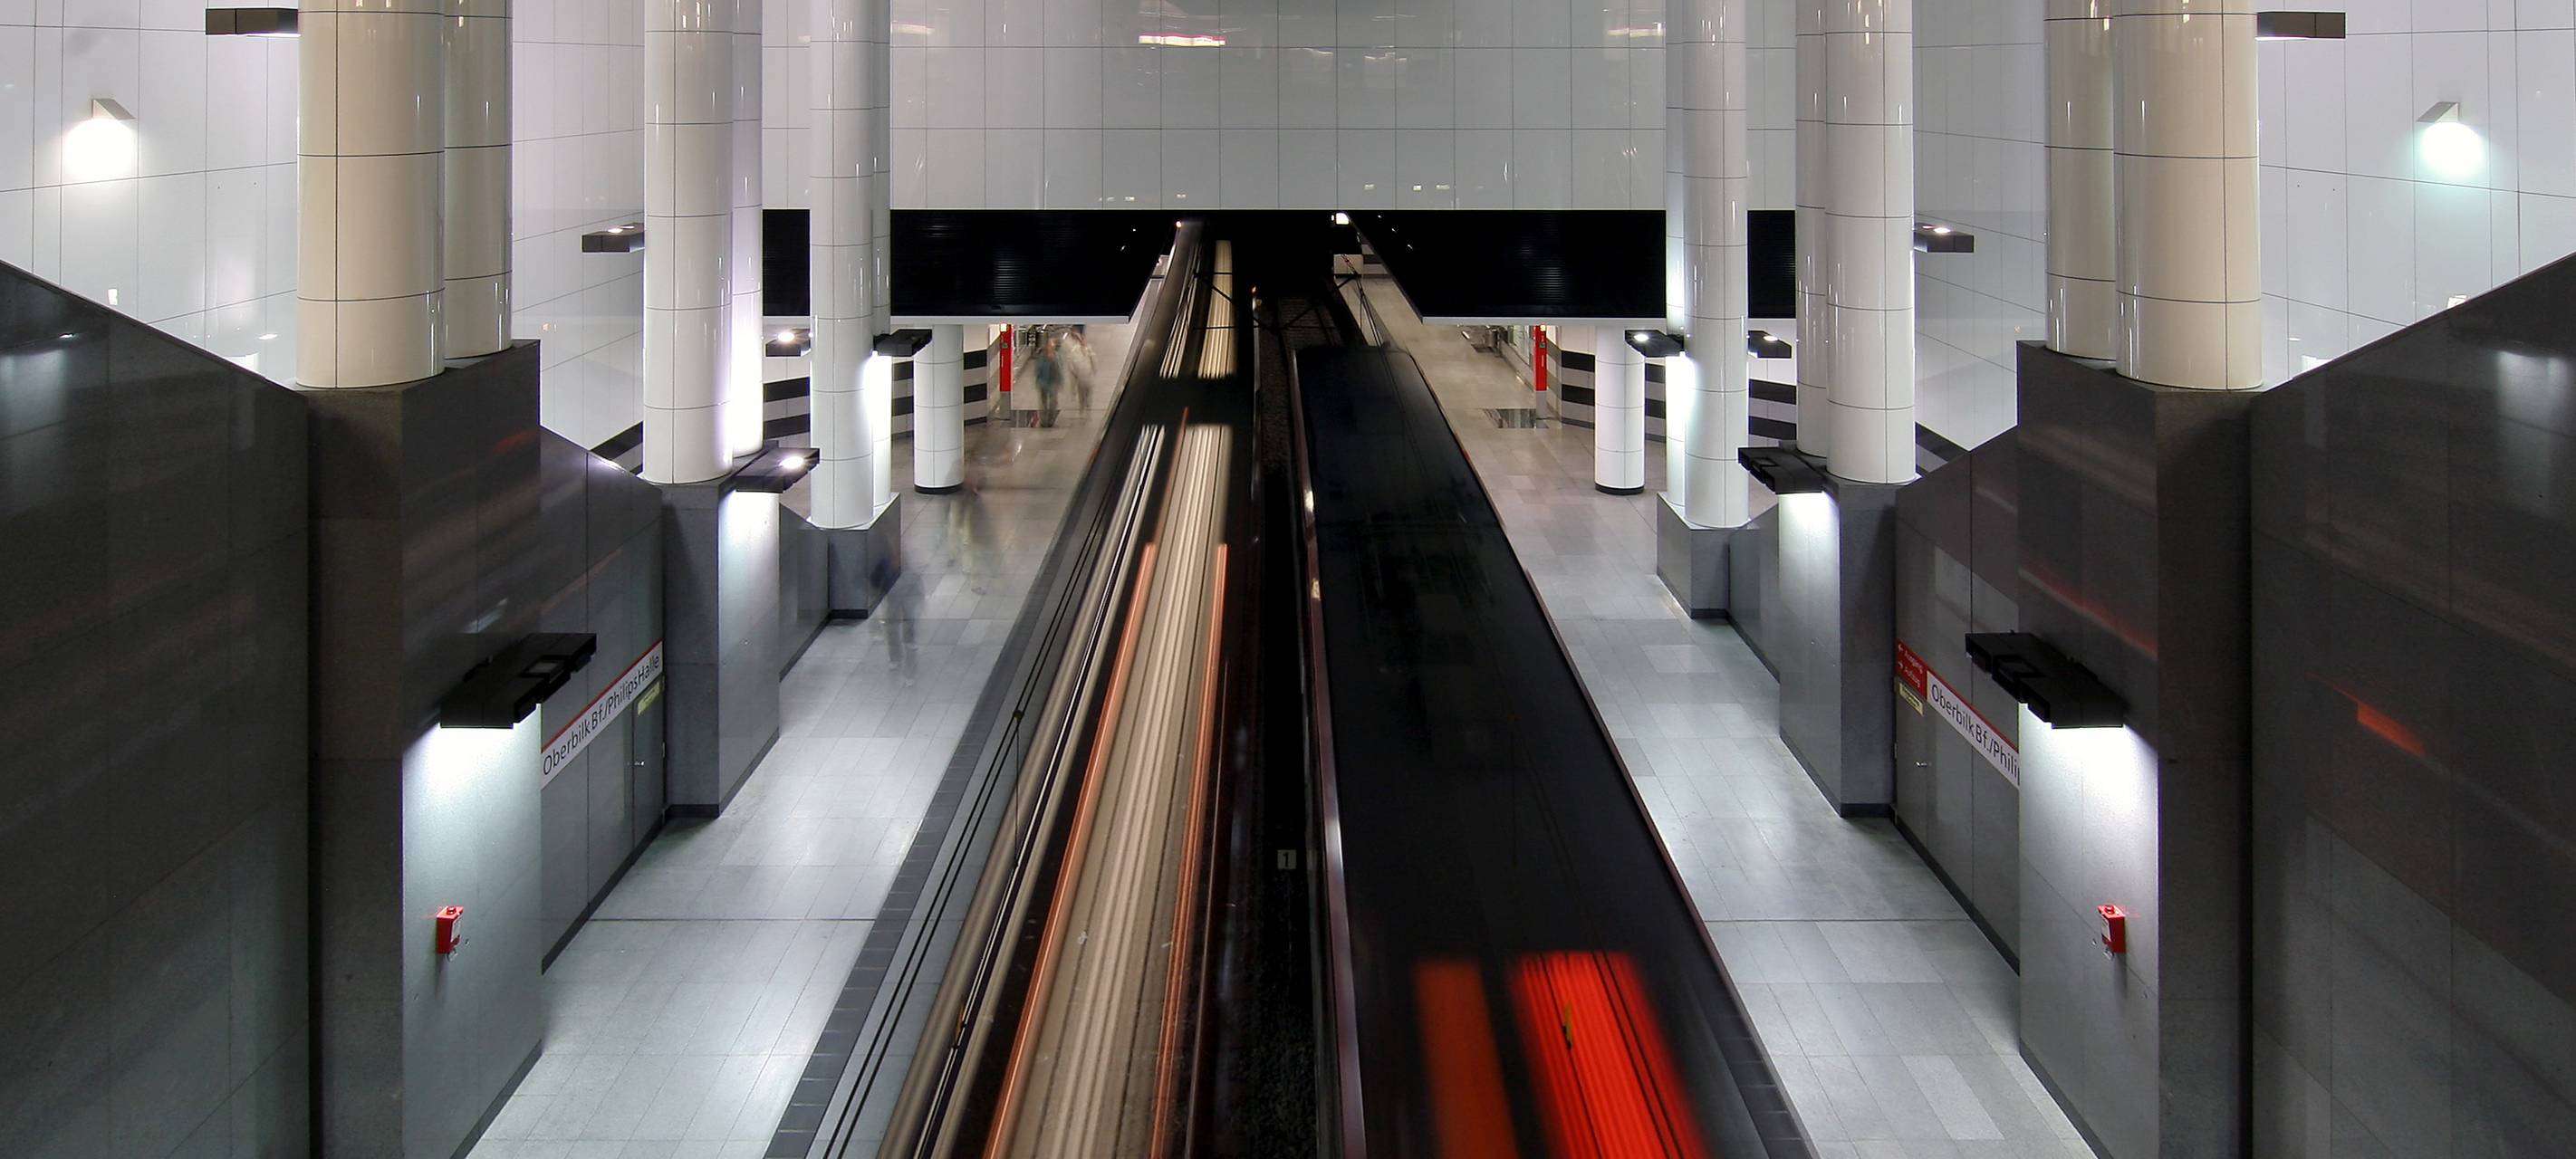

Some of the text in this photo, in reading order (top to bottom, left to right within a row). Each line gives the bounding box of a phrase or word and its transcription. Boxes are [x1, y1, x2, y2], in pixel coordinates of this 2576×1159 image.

[1931, 684, 1975, 738] Oberbilk
[543, 719, 591, 775] Oberbilk
[1282, 851, 1290, 867] 1
